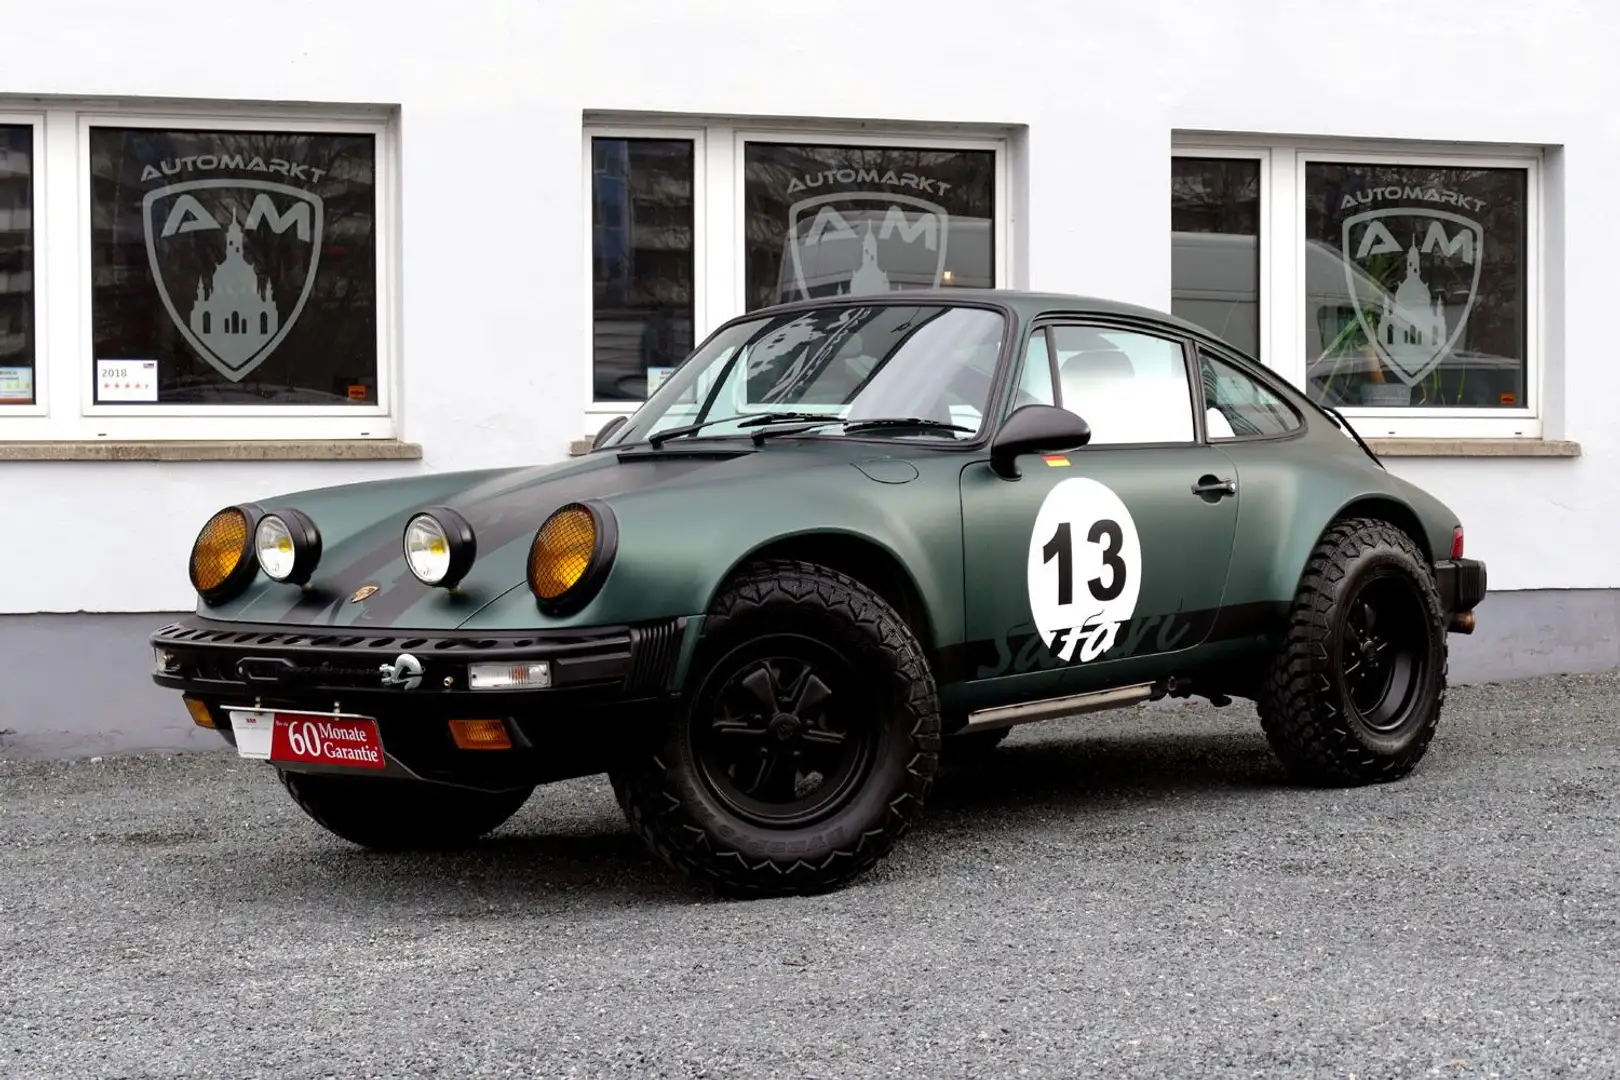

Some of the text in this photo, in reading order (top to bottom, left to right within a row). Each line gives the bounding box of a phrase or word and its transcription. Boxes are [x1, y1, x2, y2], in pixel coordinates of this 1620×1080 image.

[141, 155, 327, 183] AUTOMARKT
[787, 169, 951, 196] AUTOMARKT
[1340, 186, 1486, 212] AUTOMARKT
[102, 368, 127, 378] 2018
[1042, 519, 1127, 606] 13
[288, 721, 368, 757] 60 Monate
